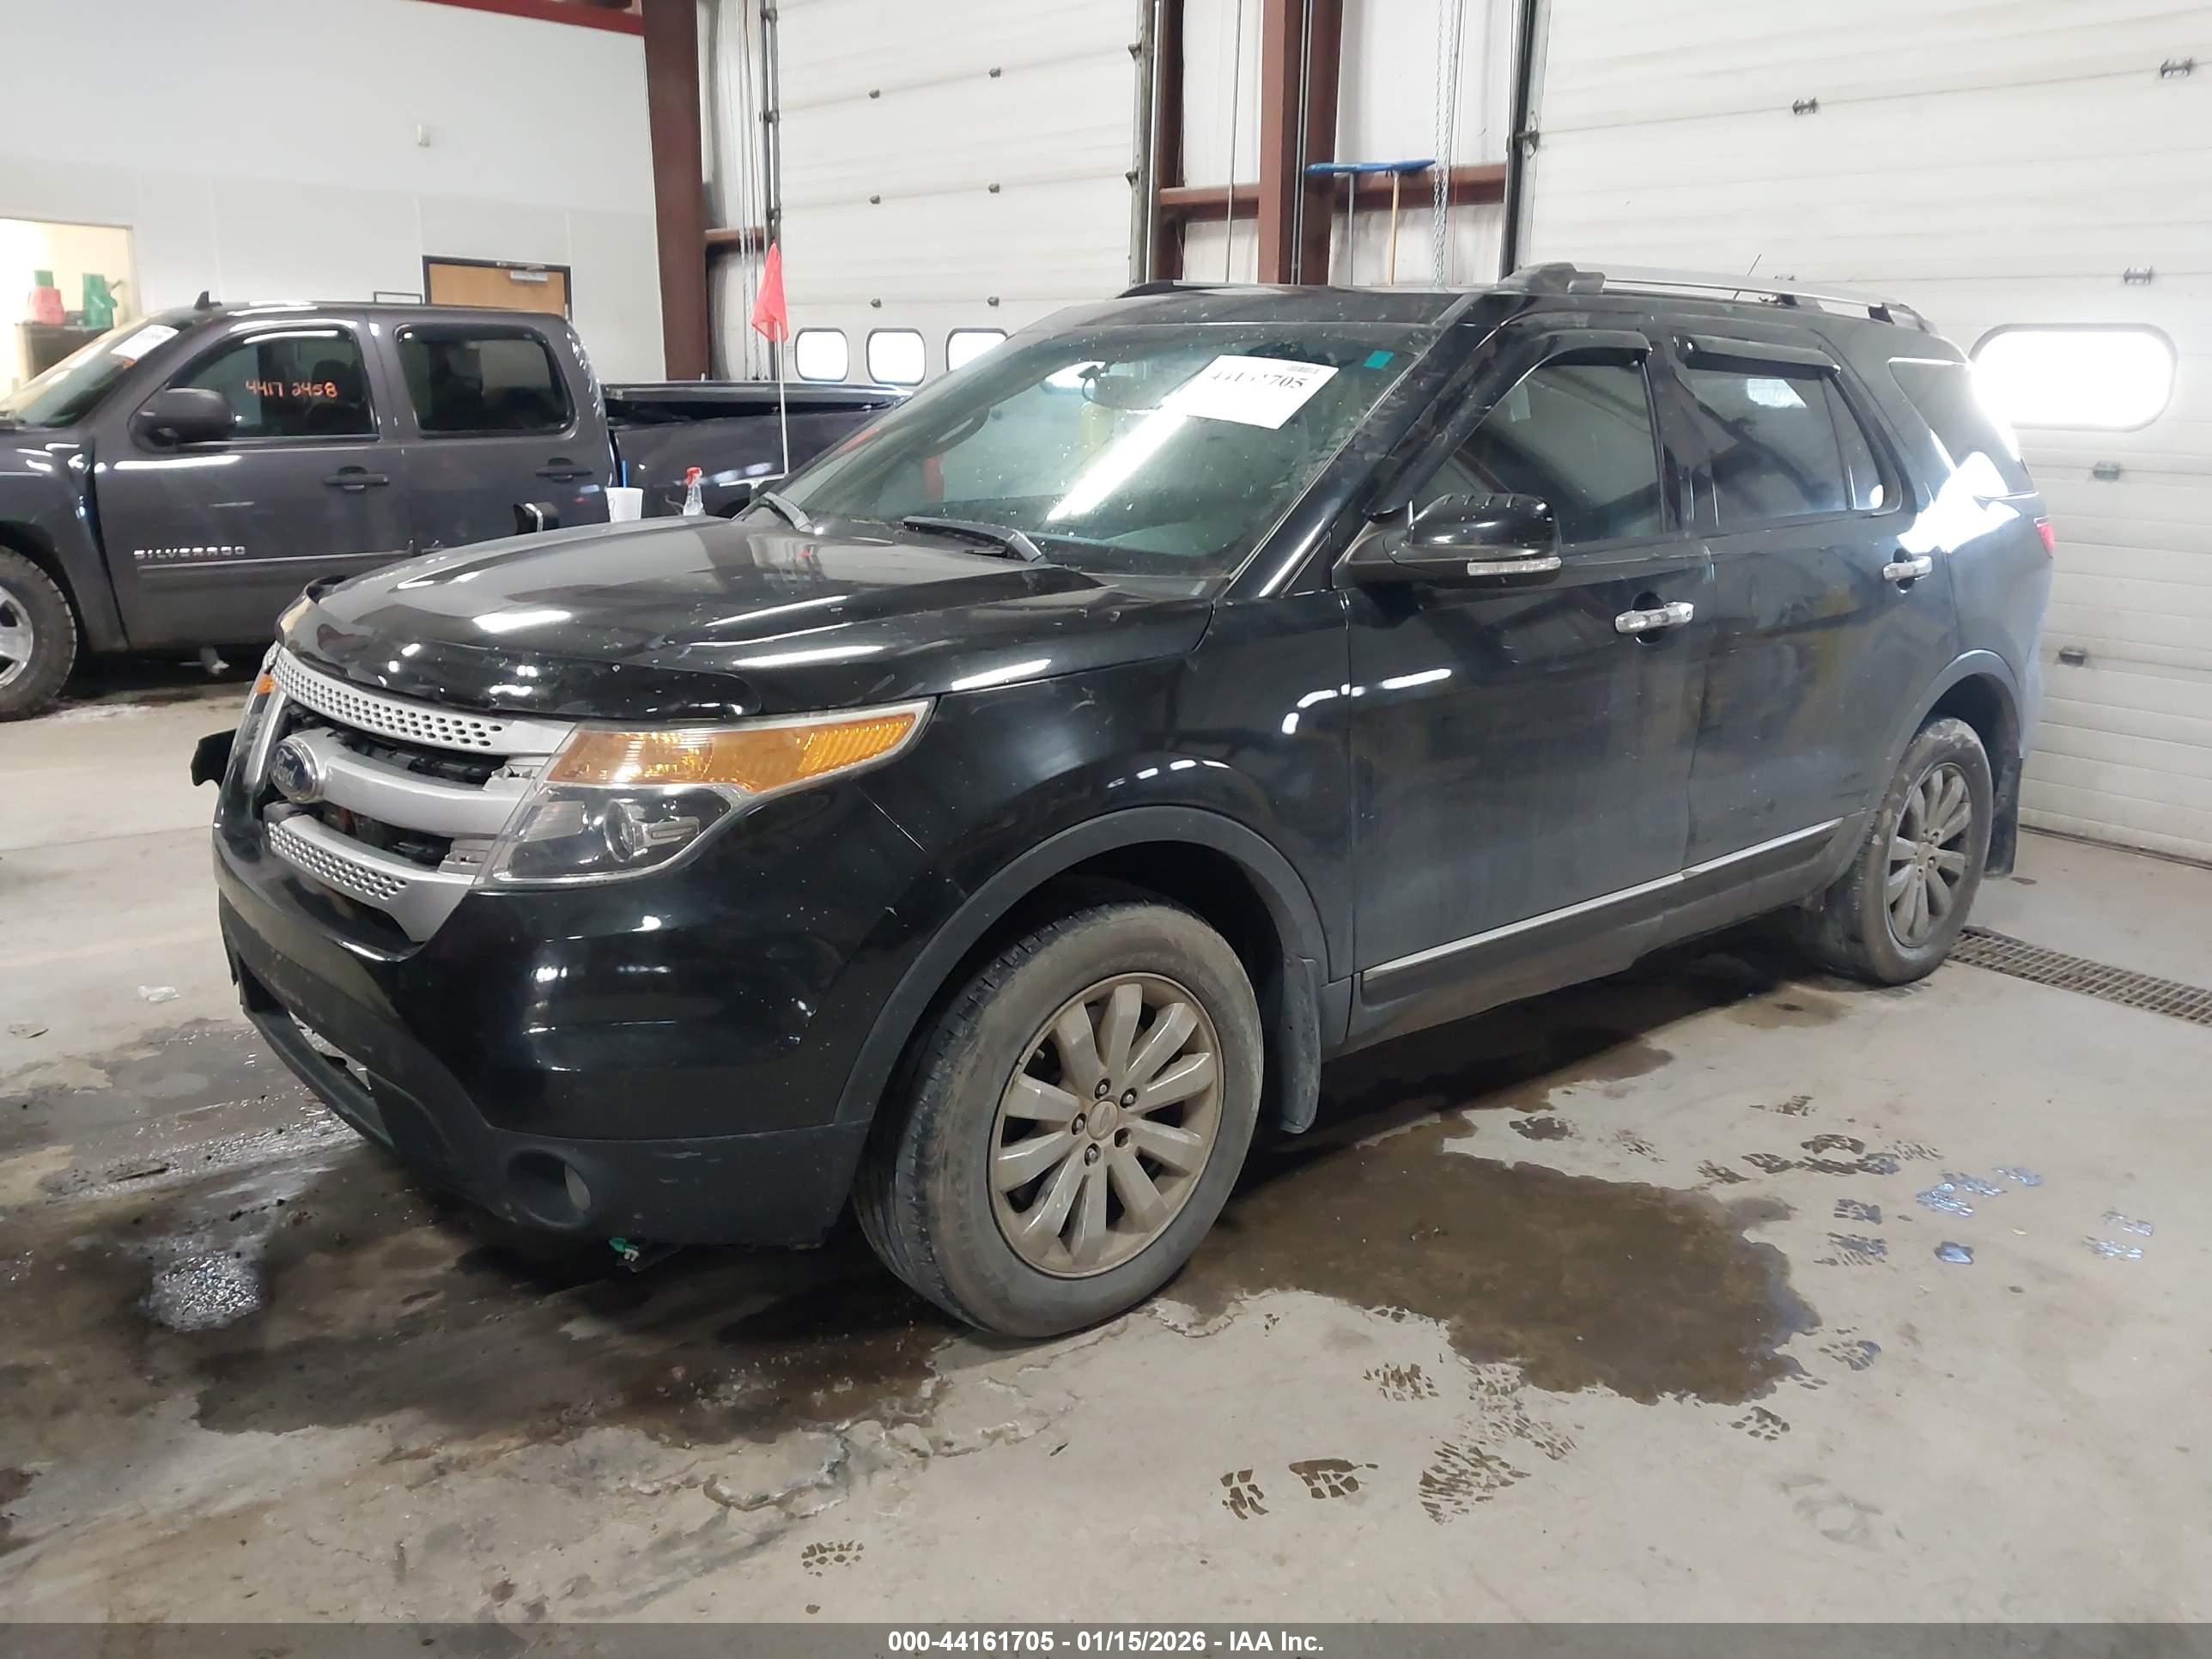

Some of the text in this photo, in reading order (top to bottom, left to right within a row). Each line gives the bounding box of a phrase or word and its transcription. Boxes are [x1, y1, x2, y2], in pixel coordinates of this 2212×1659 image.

[246, 380, 283, 397] 4417
[133, 545, 246, 560] SILVERADO
[272, 747, 298, 787] Ford
